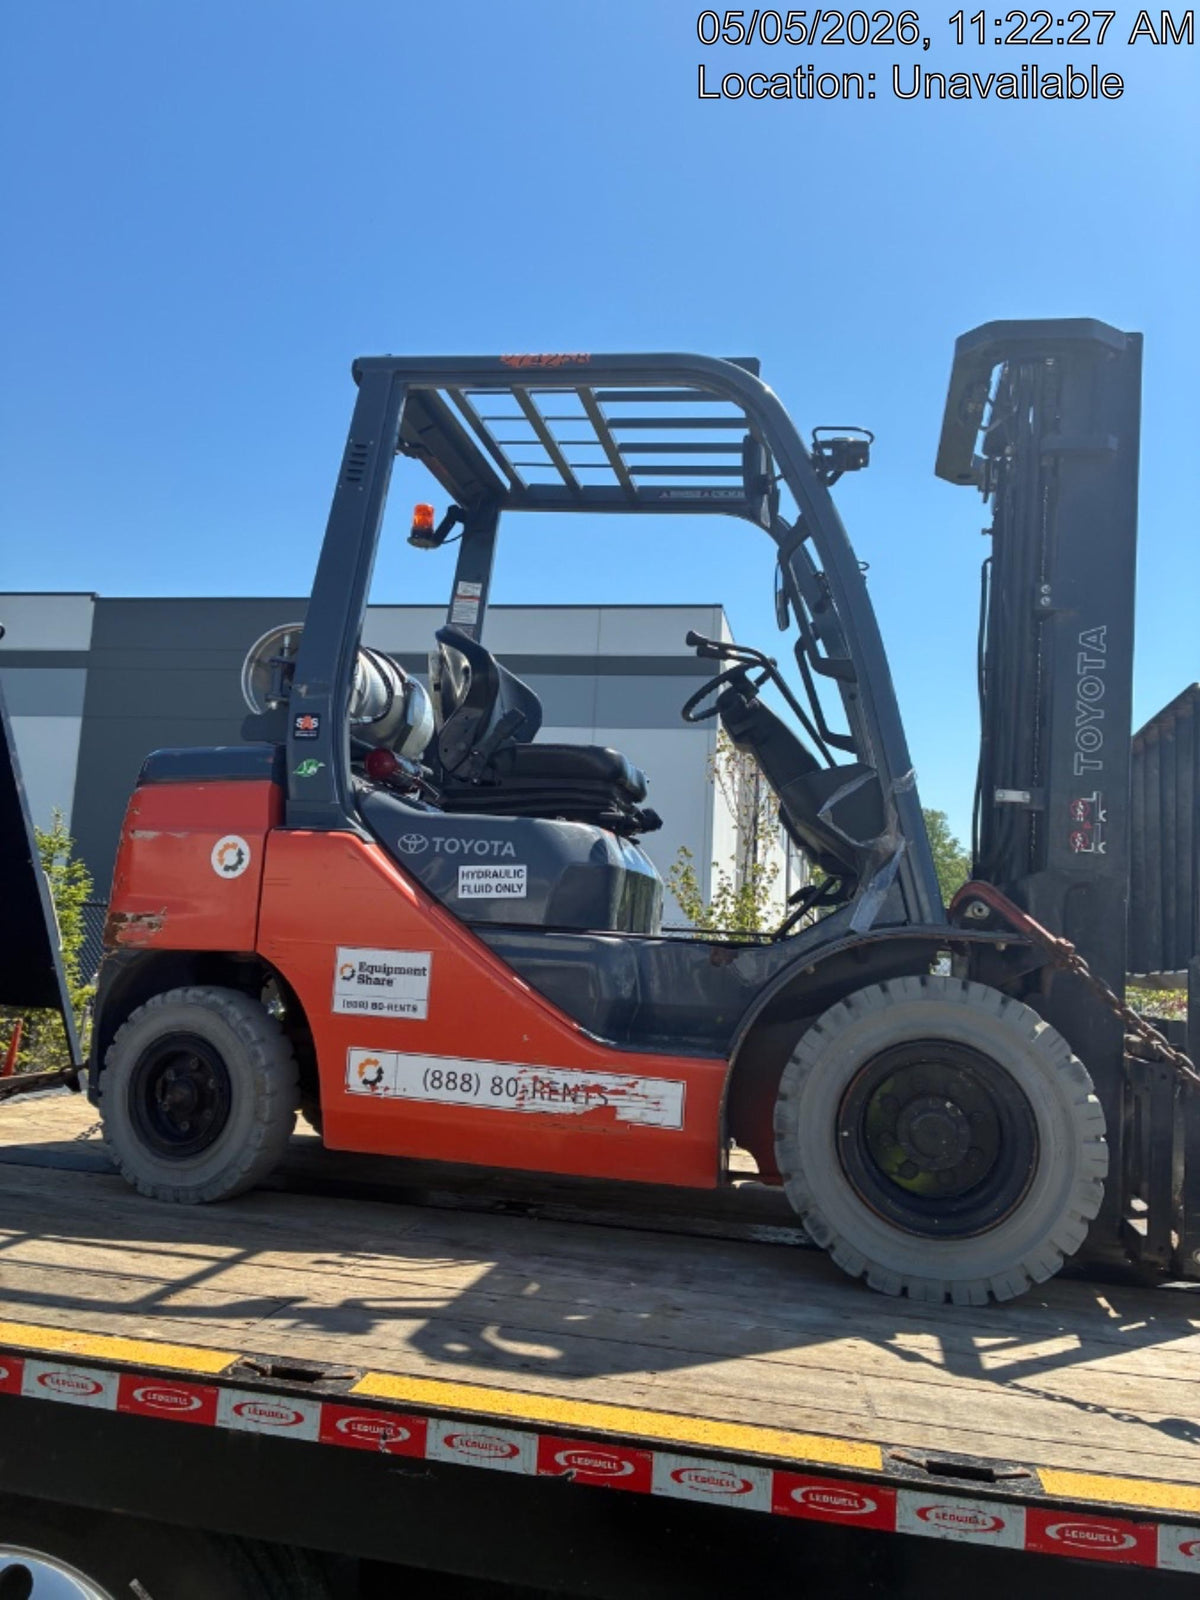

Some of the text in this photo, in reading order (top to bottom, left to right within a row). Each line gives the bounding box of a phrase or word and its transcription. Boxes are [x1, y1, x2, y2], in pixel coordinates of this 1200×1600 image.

[1073, 625, 1107, 775] TOYOTA
[432, 837, 516, 858] TOYOTA
[461, 868, 525, 880] HYDRAULIC
[461, 882, 523, 894] FLUID ONLY
[358, 962, 427, 976] Equipment
[356, 974, 394, 987] Share
[422, 1068, 481, 1096] (888)
[808, 1493, 860, 1508] LEDWELL
[1064, 1528, 1119, 1544] LEDWELL
